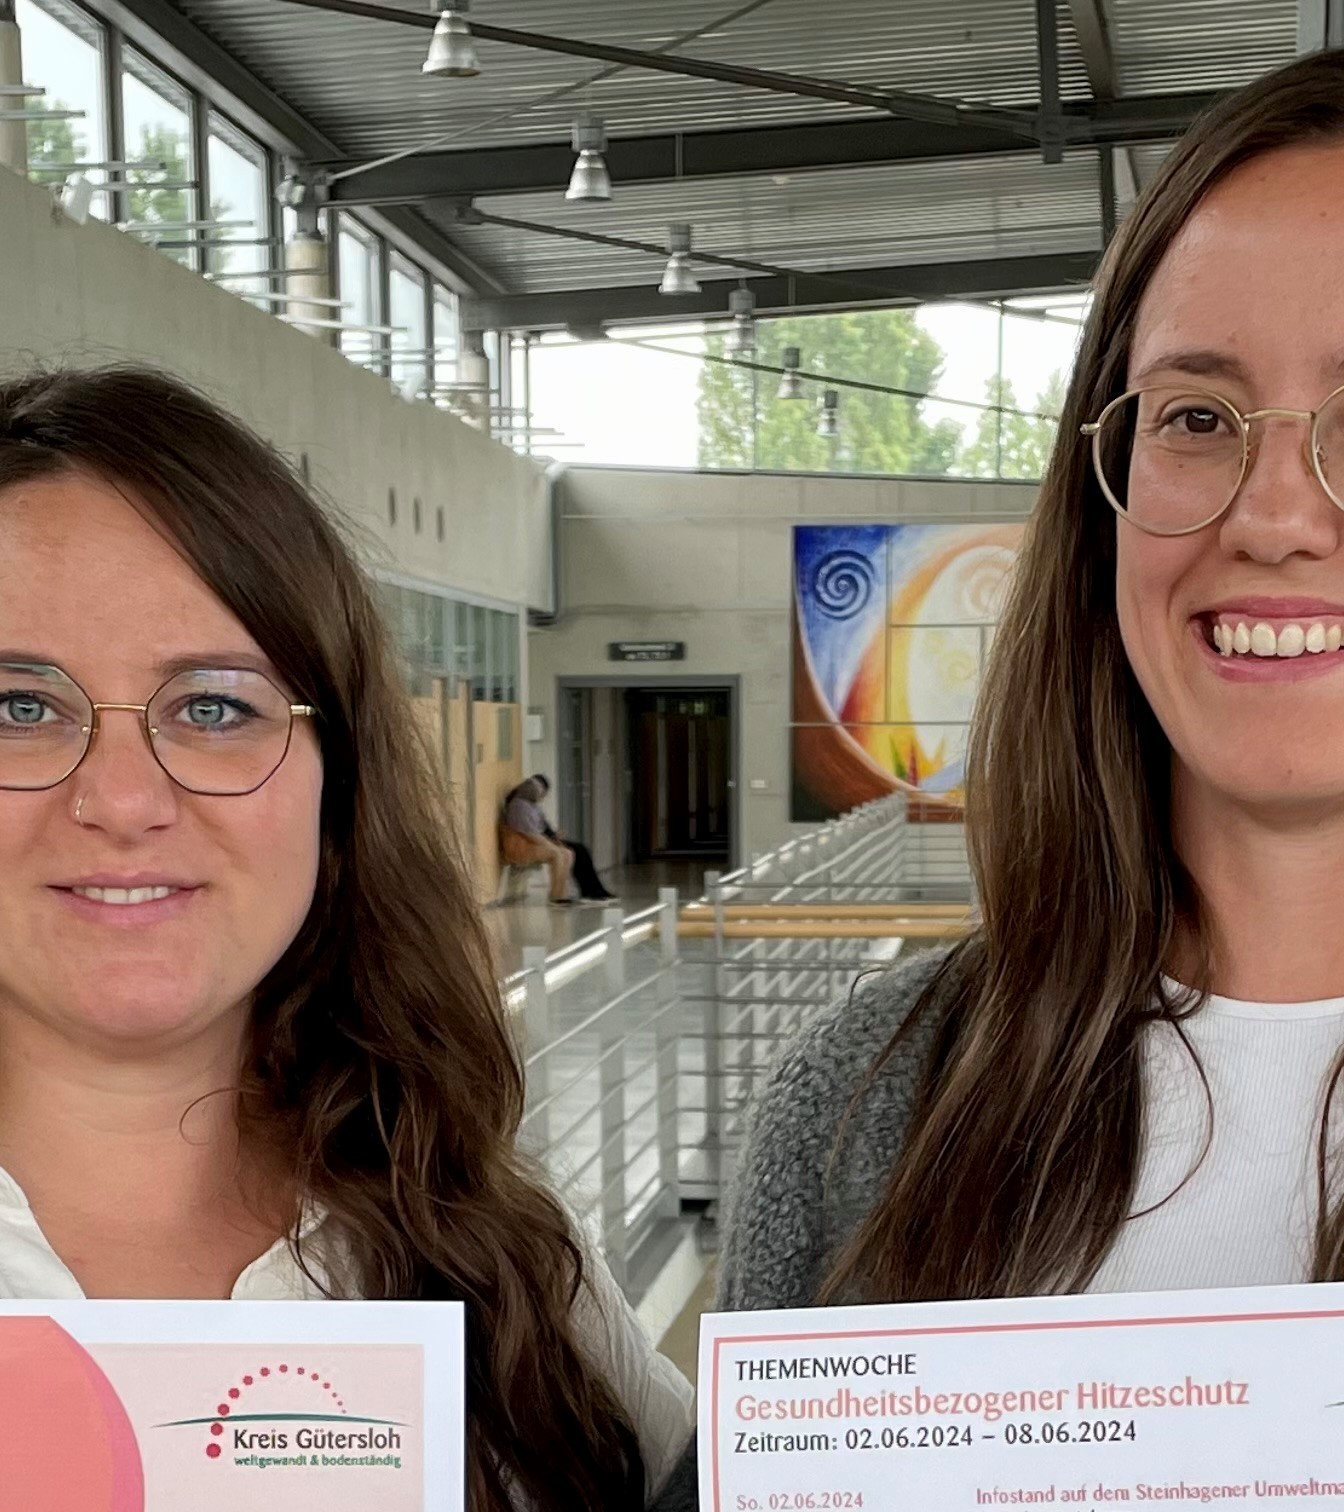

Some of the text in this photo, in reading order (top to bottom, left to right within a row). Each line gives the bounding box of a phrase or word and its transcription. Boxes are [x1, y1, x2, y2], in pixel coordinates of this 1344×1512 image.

[735, 1353, 916, 1381] THEMENWOCHE
[735, 1375, 1250, 1422] Gesundheitsbezogener Hitzeschutz
[234, 1427, 401, 1450] Kreis Gütersloh
[734, 1432, 838, 1454] Zeitraum:
[845, 1425, 973, 1450] 02.06.2024
[1004, 1419, 1136, 1445] 08.06.2024
[233, 1454, 402, 1469] weltgewandt & bodenständig
[736, 1491, 864, 1511] So. 02.06.2024
[976, 1484, 1055, 1505] Infostand
[1060, 1484, 1087, 1503] auf
[1092, 1482, 1130, 1502] dem
[1136, 1480, 1251, 1503] Steinhagener
